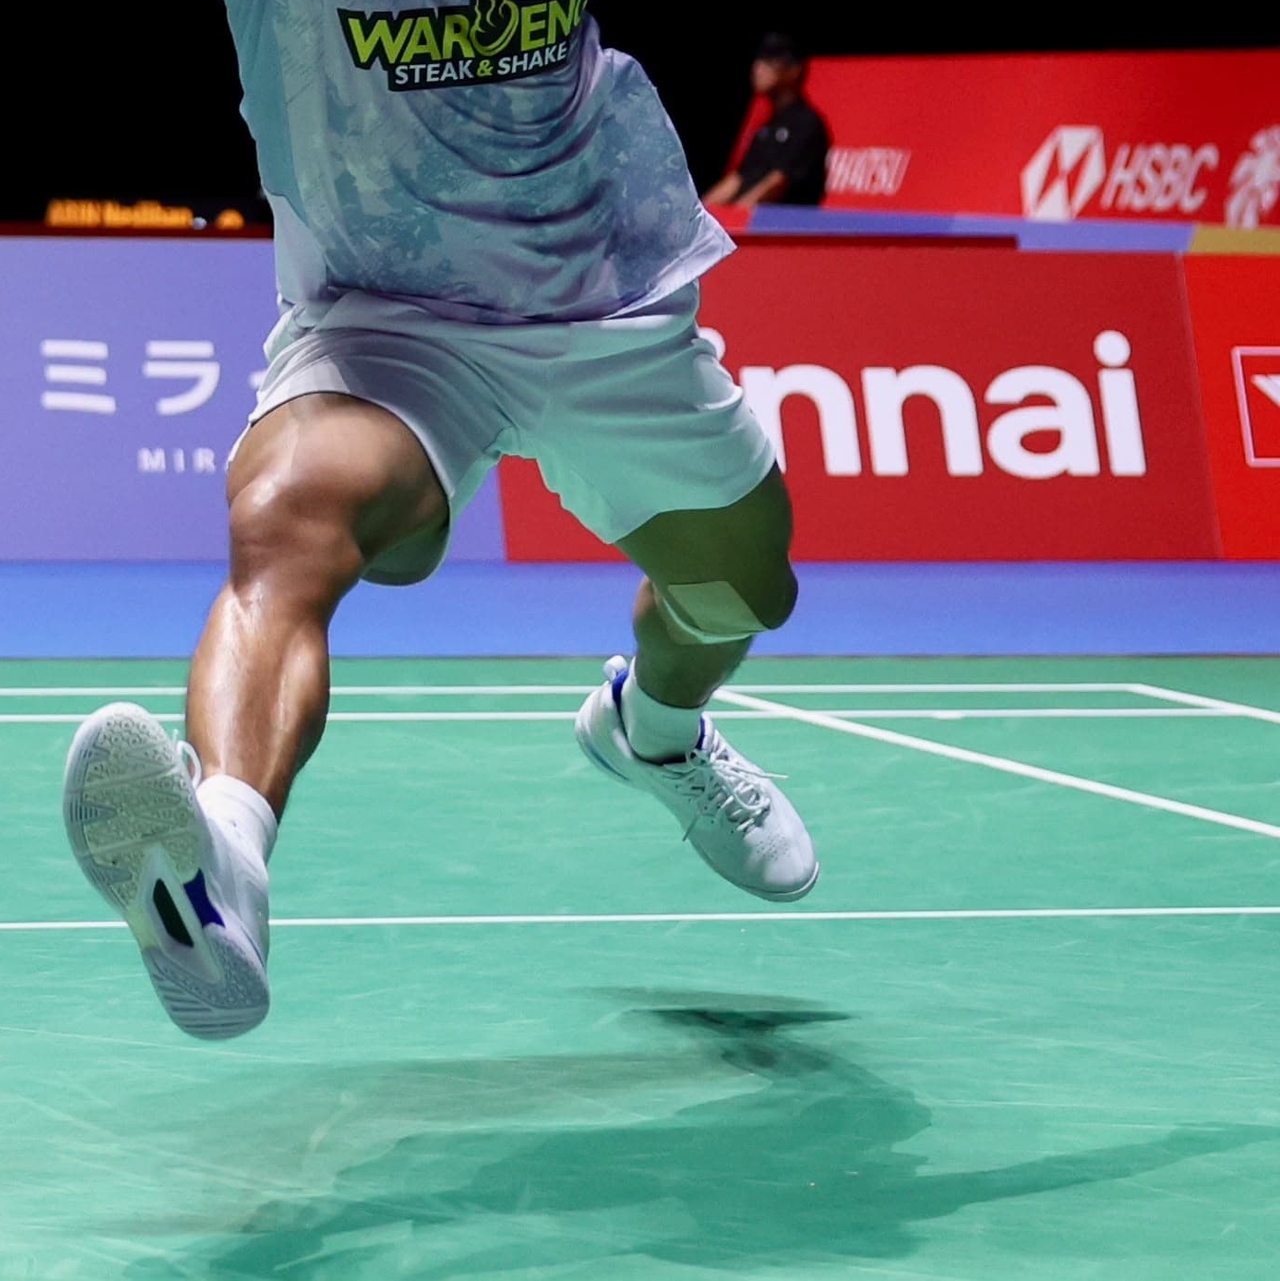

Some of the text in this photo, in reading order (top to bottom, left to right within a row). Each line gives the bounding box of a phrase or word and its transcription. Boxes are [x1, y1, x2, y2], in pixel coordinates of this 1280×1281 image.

[395, 41, 568, 86] STEAK & SHAKE
[1099, 142, 1220, 215] HSBC
[42, 339, 268, 415] ミラ
[700, 327, 1147, 478] nnai
[138, 447, 217, 473] MIR
